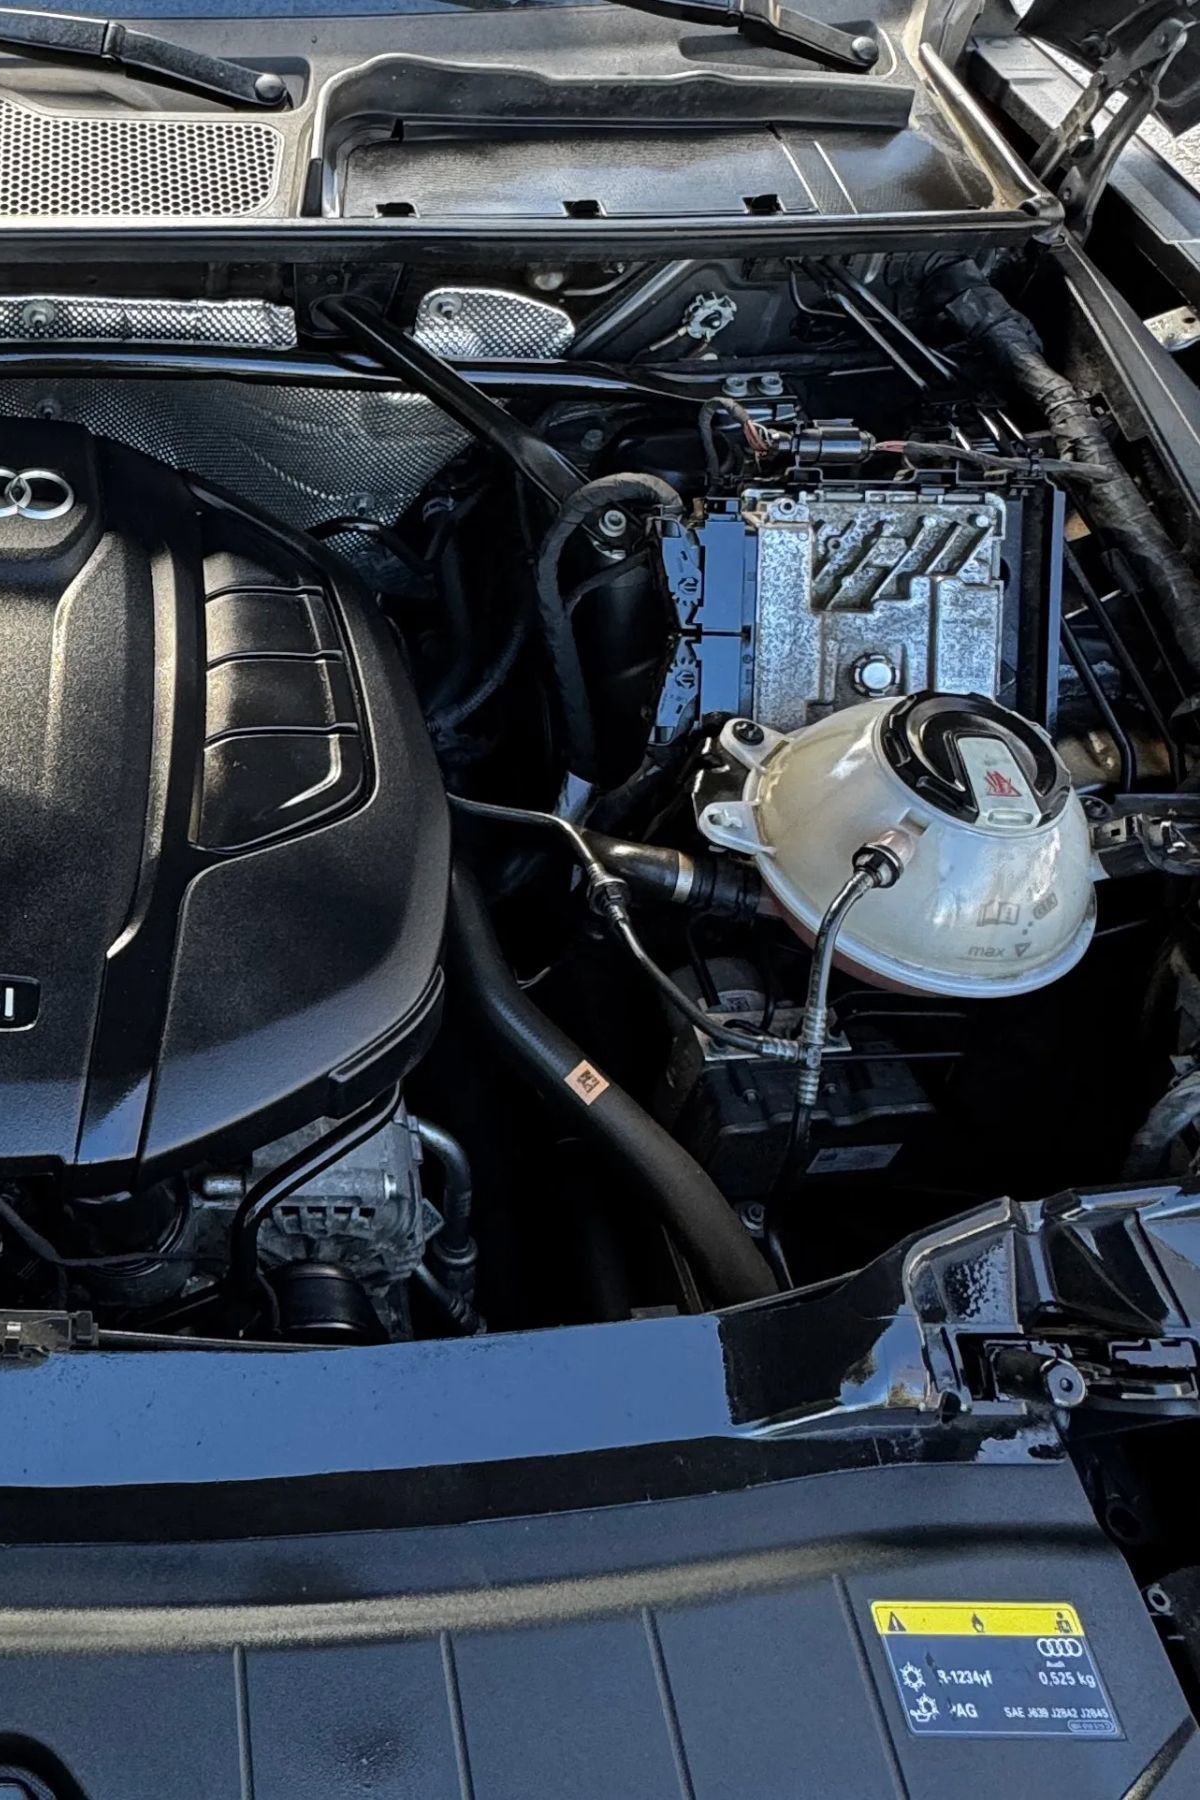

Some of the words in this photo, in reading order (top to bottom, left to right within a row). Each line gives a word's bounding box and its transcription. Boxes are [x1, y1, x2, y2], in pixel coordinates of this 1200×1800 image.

[968, 945, 1006, 958] max
[1038, 1671, 1077, 1687] 0,525
[1078, 1672, 1096, 1688] kg
[1004, 1707, 1024, 1717] SAE
